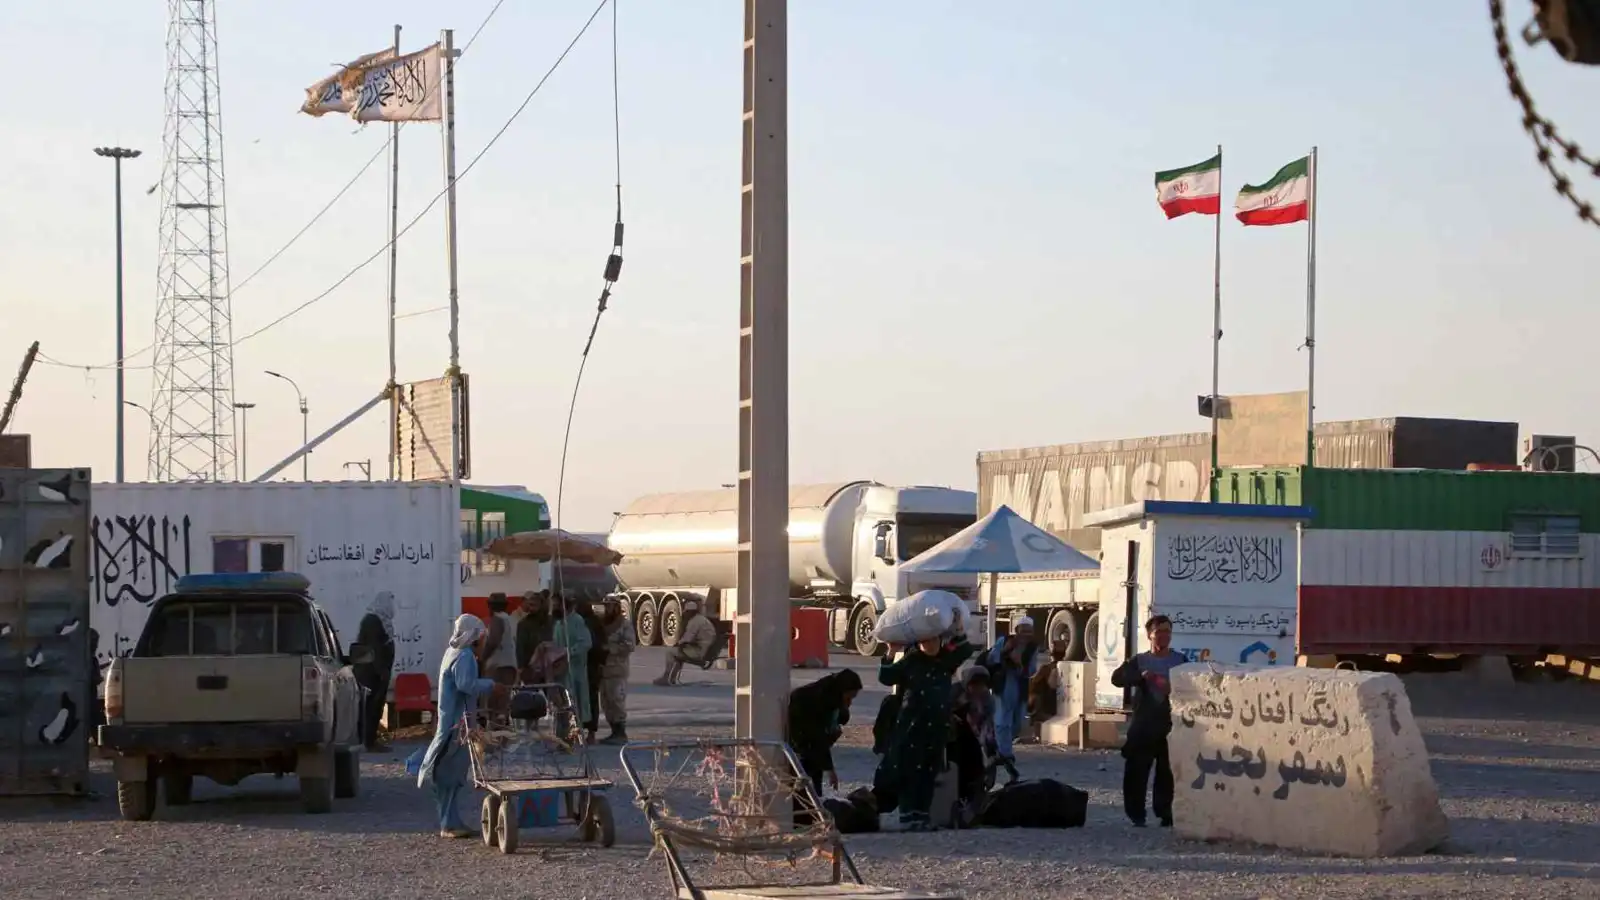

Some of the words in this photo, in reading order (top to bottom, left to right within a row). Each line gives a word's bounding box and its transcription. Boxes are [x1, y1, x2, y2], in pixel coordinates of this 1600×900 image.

[306, 543, 365, 565] افغانستان
[1239, 690, 1294, 727] افغان
[1190, 732, 1267, 795] بخیر
[1273, 737, 1347, 800] سفر
